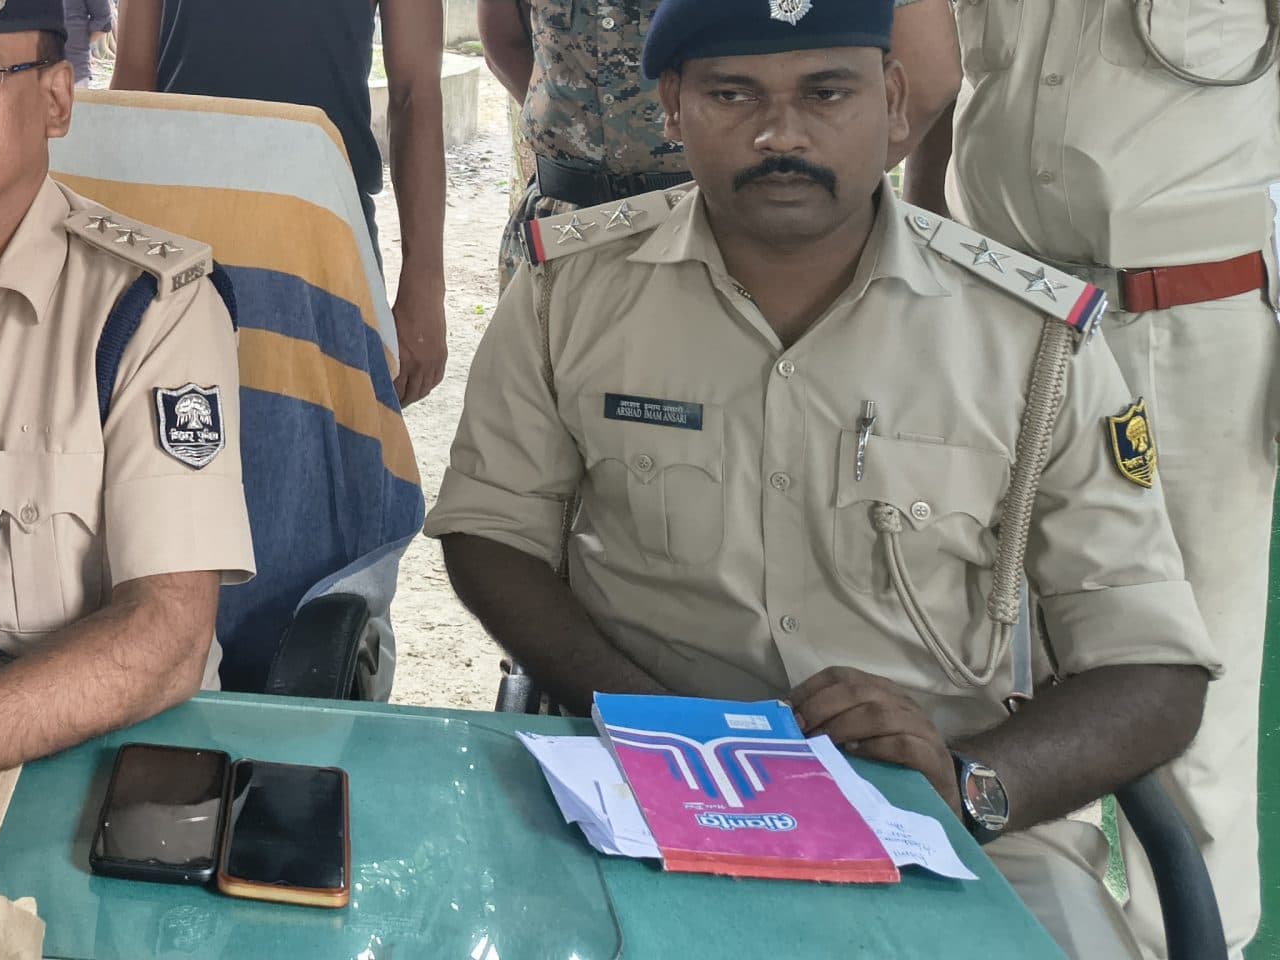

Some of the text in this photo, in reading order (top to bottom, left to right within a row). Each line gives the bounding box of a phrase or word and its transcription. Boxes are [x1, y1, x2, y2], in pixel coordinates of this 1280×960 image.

[616, 406, 687, 424] ARSHAD IMAM ANSARI
[696, 812, 797, 831] Ajanta
